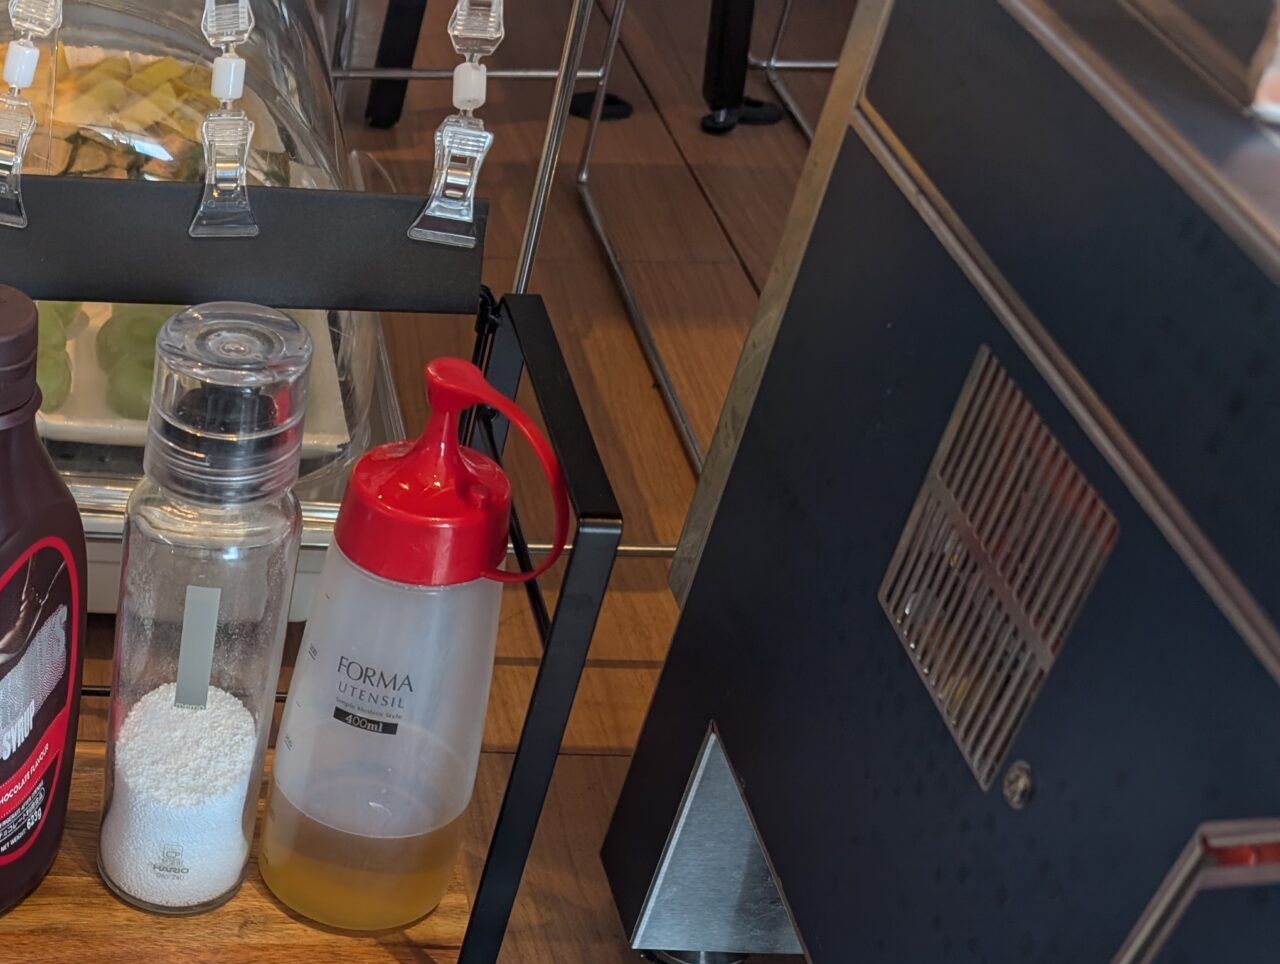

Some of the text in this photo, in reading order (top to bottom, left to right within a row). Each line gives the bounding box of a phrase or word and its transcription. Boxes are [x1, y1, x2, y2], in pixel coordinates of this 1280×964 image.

[337, 655, 413, 692] FORMA
[338, 681, 404, 709] UTENSIL
[1, 699, 35, 761] SYRUP
[345, 714, 383, 732] 400ml
[26, 808, 42, 830] 623g
[153, 863, 190, 873] HARIO
